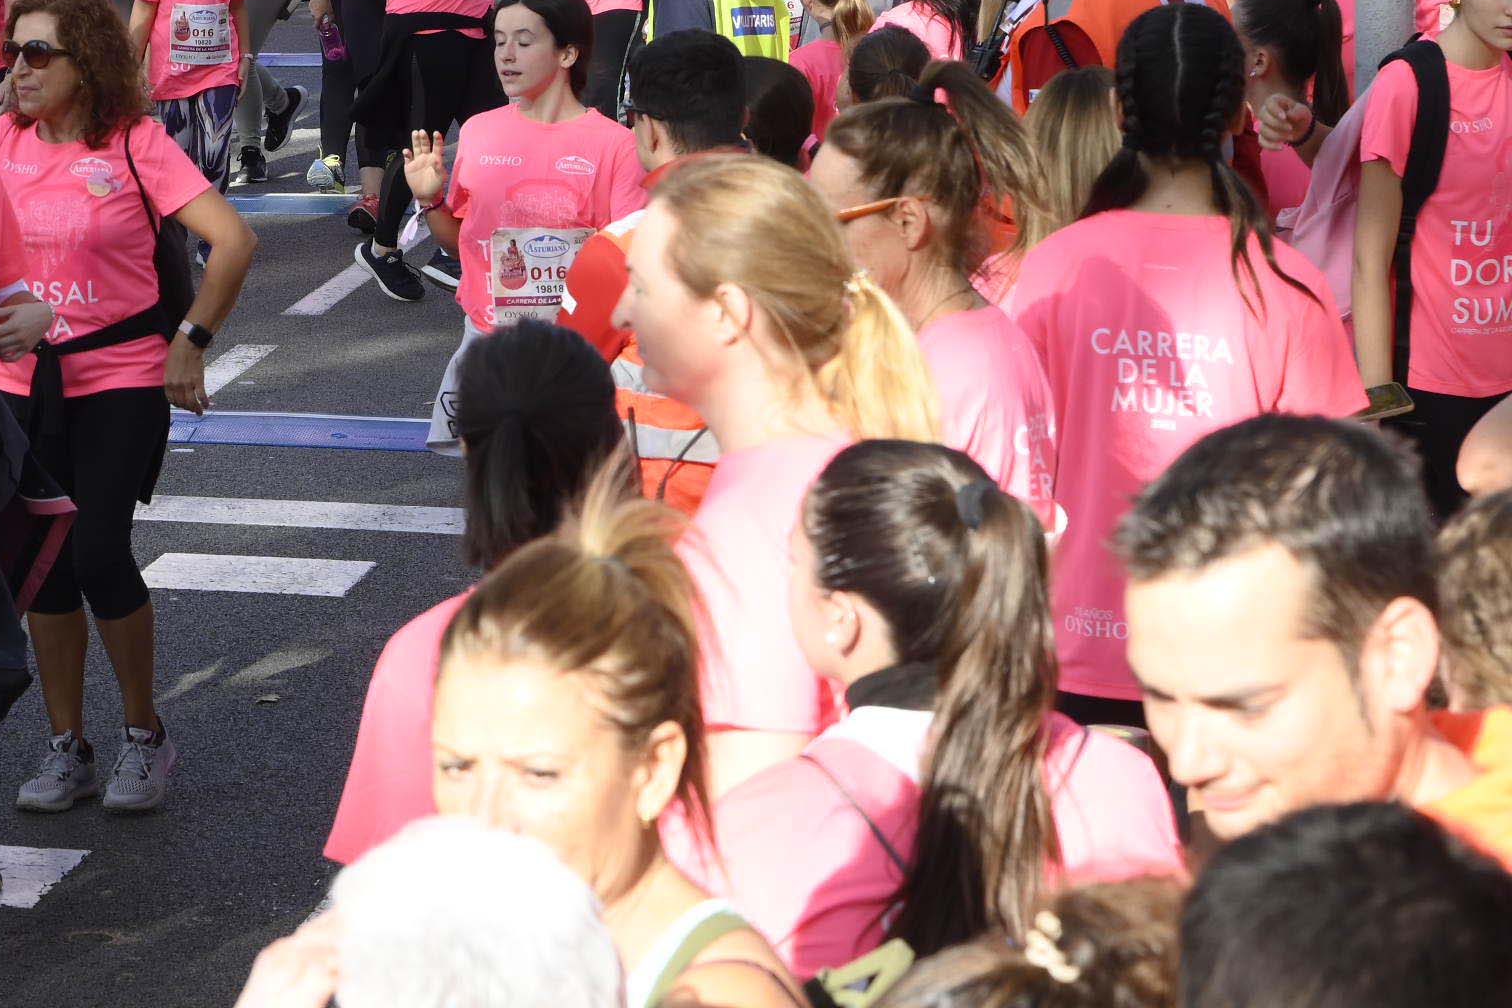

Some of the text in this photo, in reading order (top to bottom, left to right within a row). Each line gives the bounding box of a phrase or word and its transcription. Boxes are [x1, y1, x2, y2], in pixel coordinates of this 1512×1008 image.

[192, 28, 214, 38] 016
[479, 154, 523, 167] OYSHO
[1450, 219, 1492, 247] TU
[528, 242, 567, 253] ASTURIANA
[530, 265, 567, 281] 016
[535, 284, 564, 294] 19818
[506, 297, 537, 305] CARRERA
[1090, 327, 1234, 365] CARRERA
[1117, 357, 1209, 389] DE LA
[1110, 385, 1215, 417] MUJER
[1064, 614, 1129, 640] OYSHO
